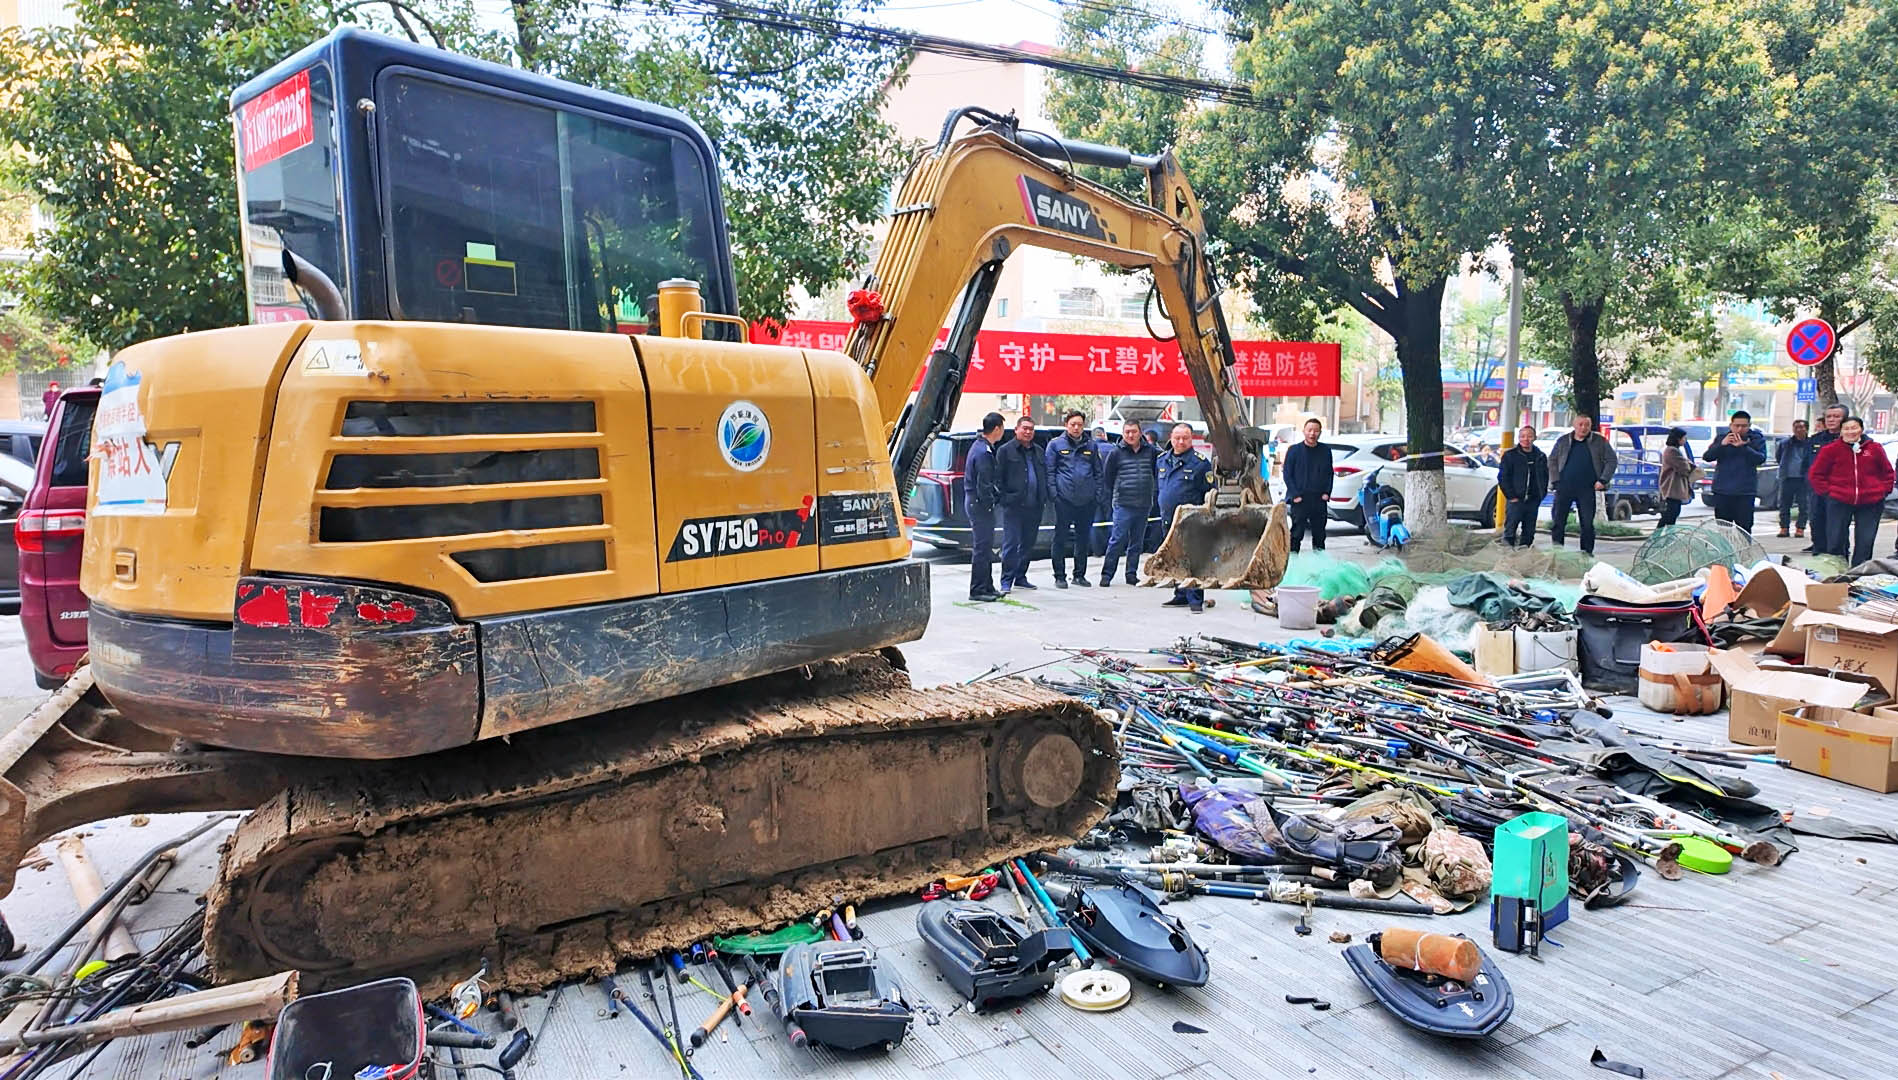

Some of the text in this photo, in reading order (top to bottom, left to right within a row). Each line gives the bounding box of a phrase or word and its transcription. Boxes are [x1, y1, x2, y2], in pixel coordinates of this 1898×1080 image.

[1036, 194, 1090, 230] SANY
[998, 342, 1166, 376] 守护一江碧水
[842, 498, 879, 512] SANY
[682, 518, 759, 556] SY75C
